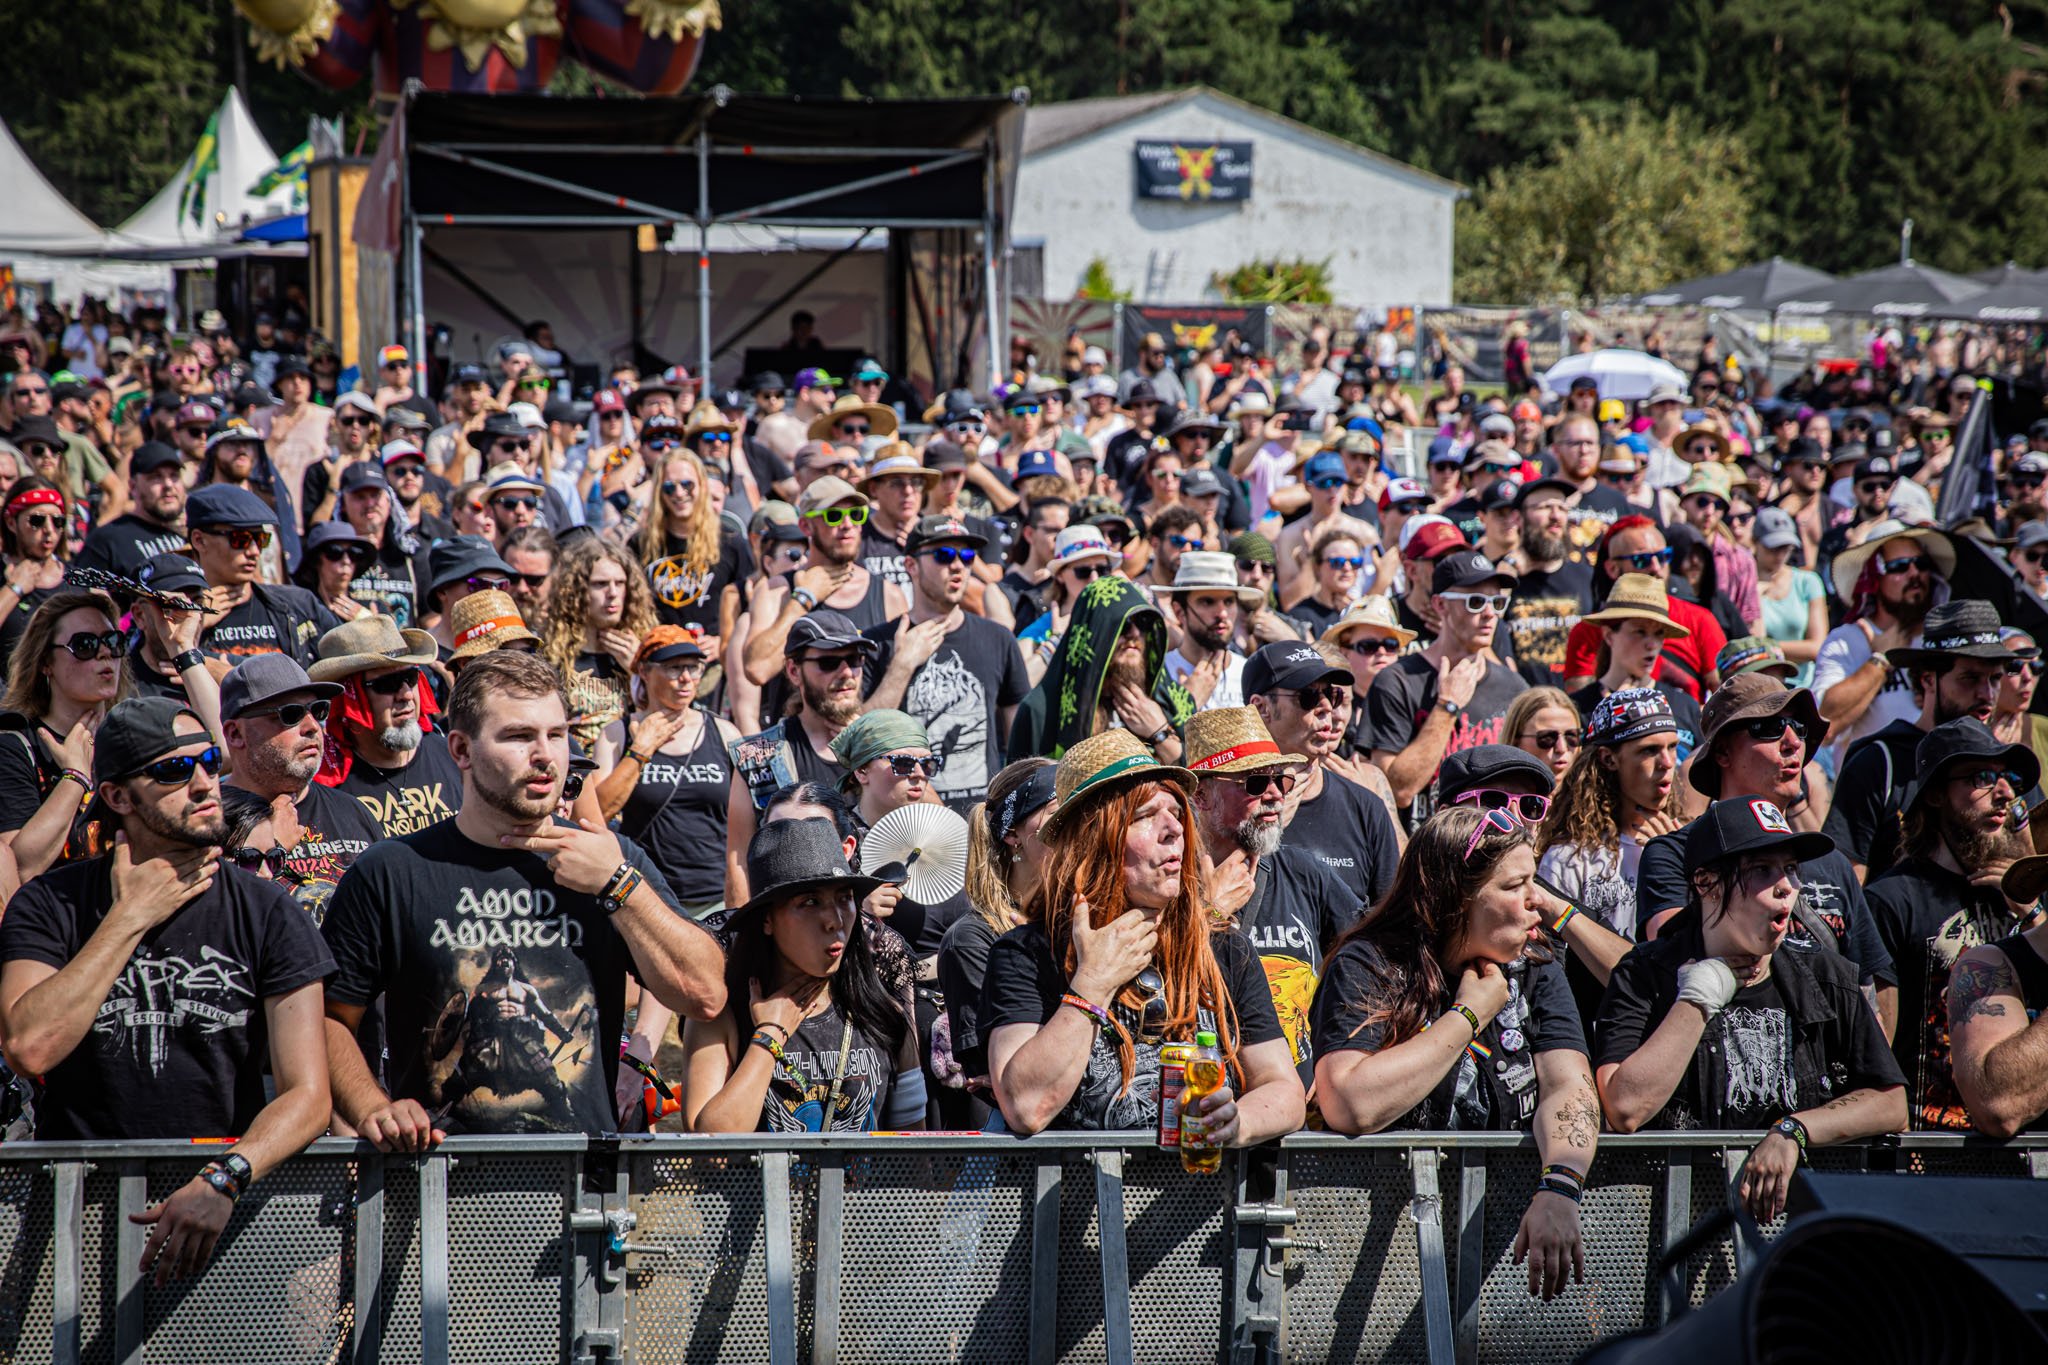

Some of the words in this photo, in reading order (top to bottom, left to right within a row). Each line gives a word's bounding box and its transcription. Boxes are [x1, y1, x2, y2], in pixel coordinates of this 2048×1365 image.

[1212, 751, 1236, 767] BIER
[455, 886, 557, 920] AMON
[189, 1001, 232, 1023] SERVICE
